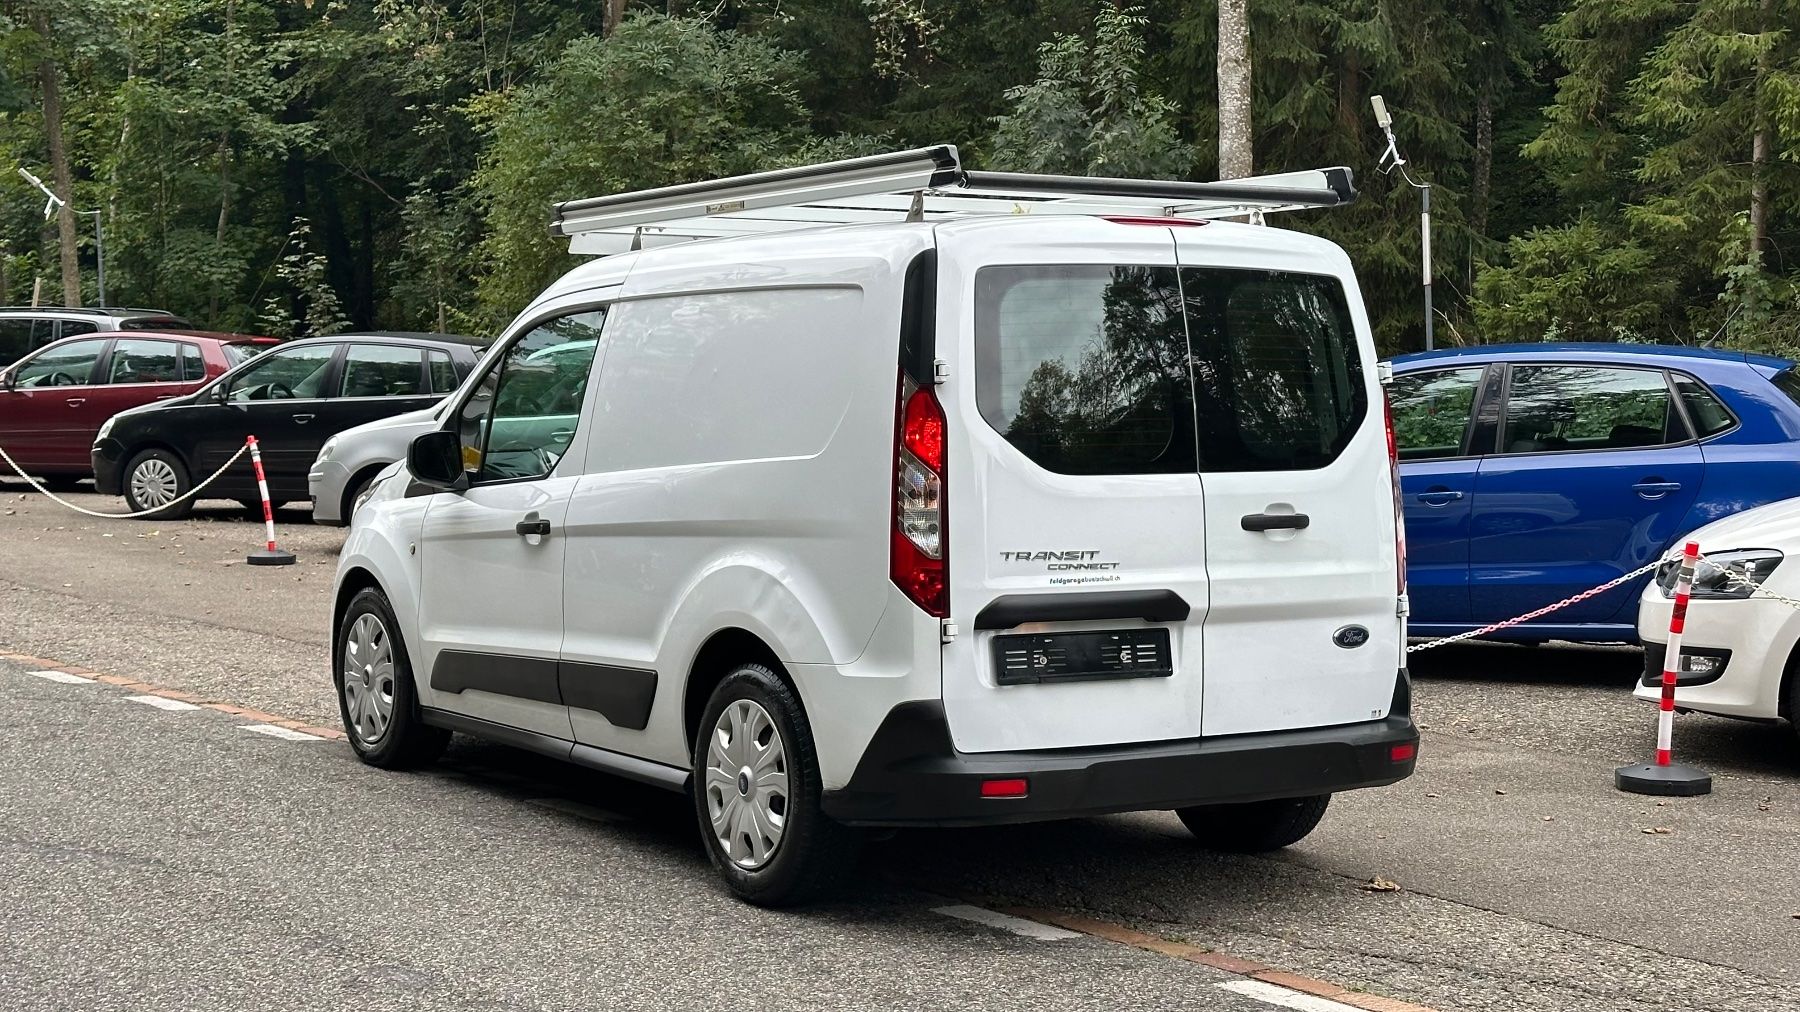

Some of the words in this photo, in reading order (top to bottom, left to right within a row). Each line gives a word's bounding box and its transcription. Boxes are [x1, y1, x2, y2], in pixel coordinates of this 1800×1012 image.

[1000, 550, 1100, 562] TRANSIT
[1047, 562, 1120, 571] CONNECT
[1343, 629, 1364, 643] Ford
